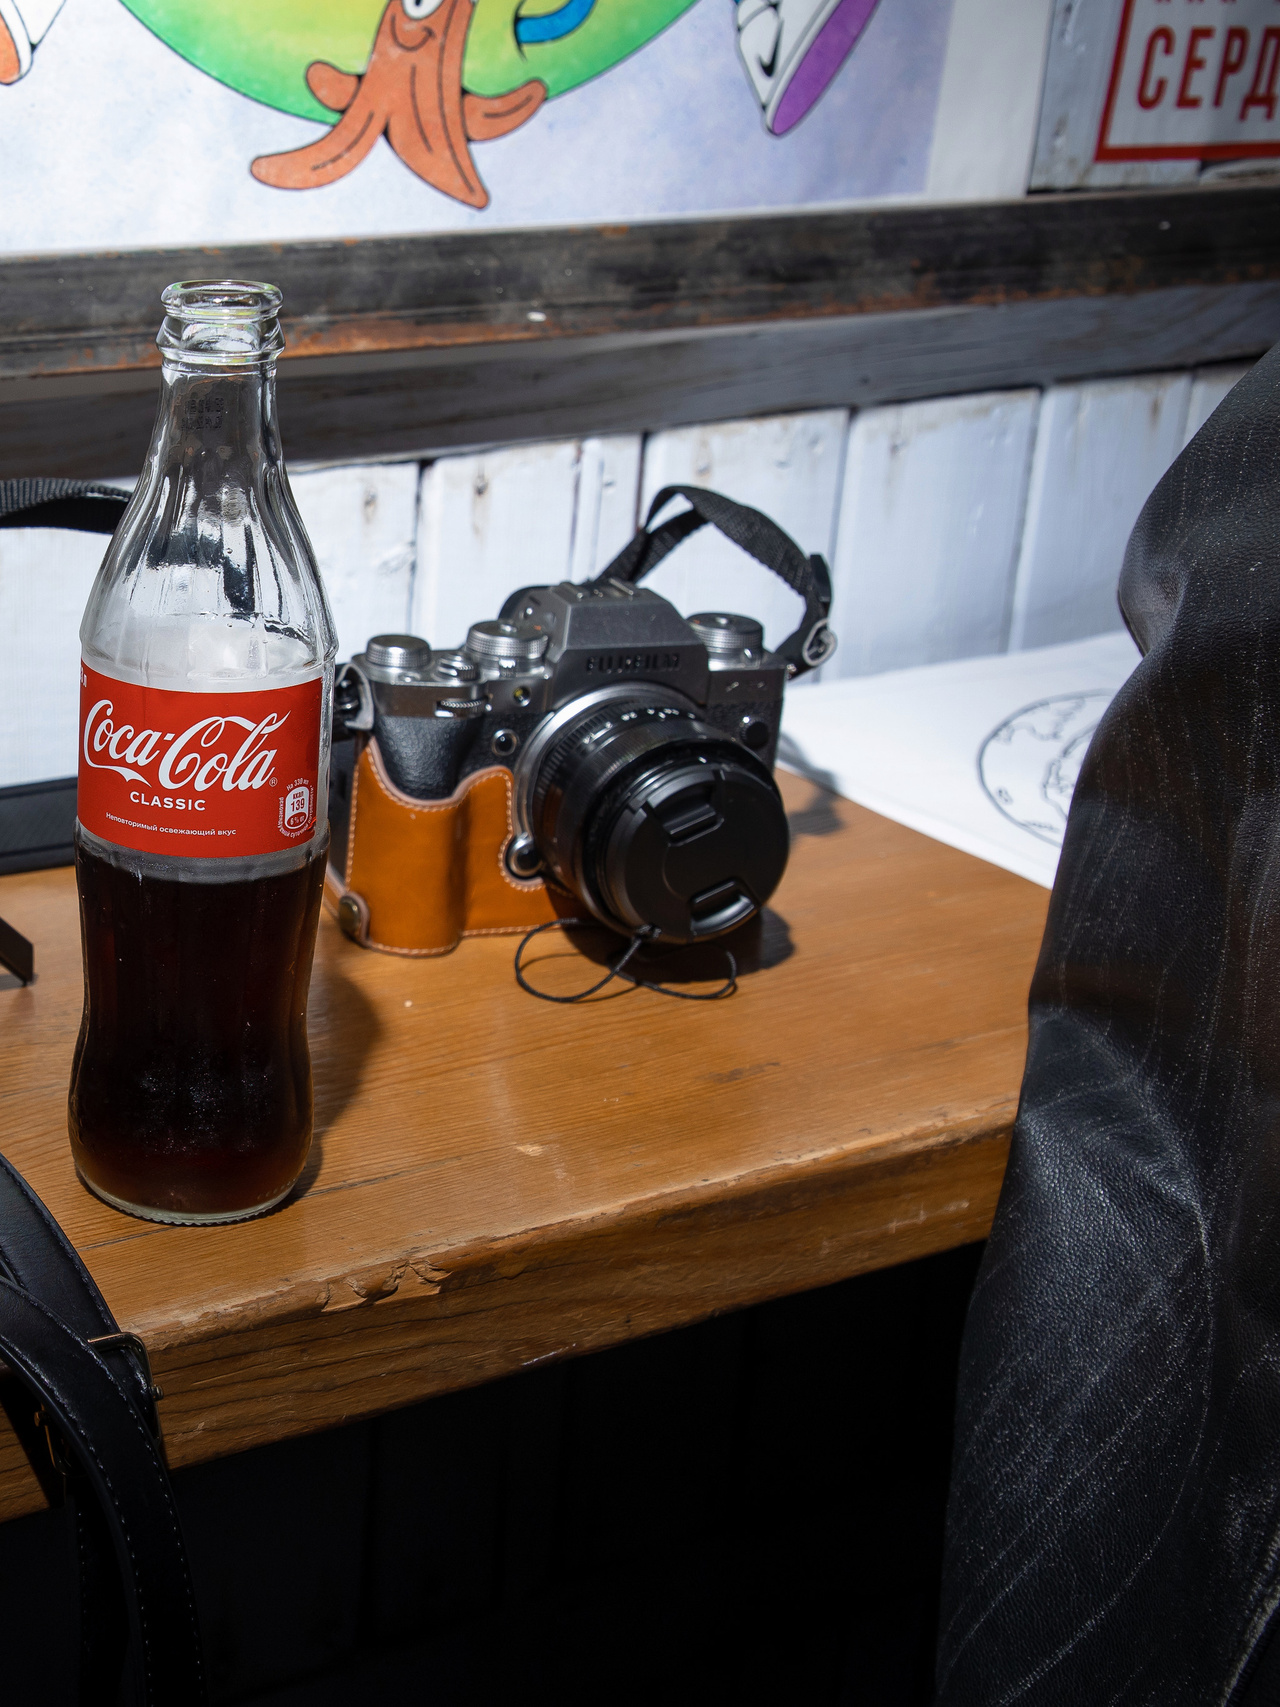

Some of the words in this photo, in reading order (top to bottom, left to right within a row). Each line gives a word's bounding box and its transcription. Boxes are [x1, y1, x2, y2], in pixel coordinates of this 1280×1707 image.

[586, 653, 680, 674] FUJIFILM
[84, 699, 291, 791] Coca-Cola
[130, 791, 206, 811] CLASSIC
[291, 798, 304, 811] 139
[105, 811, 158, 831] Неповторимый
[159, 826, 216, 836] освежающий
